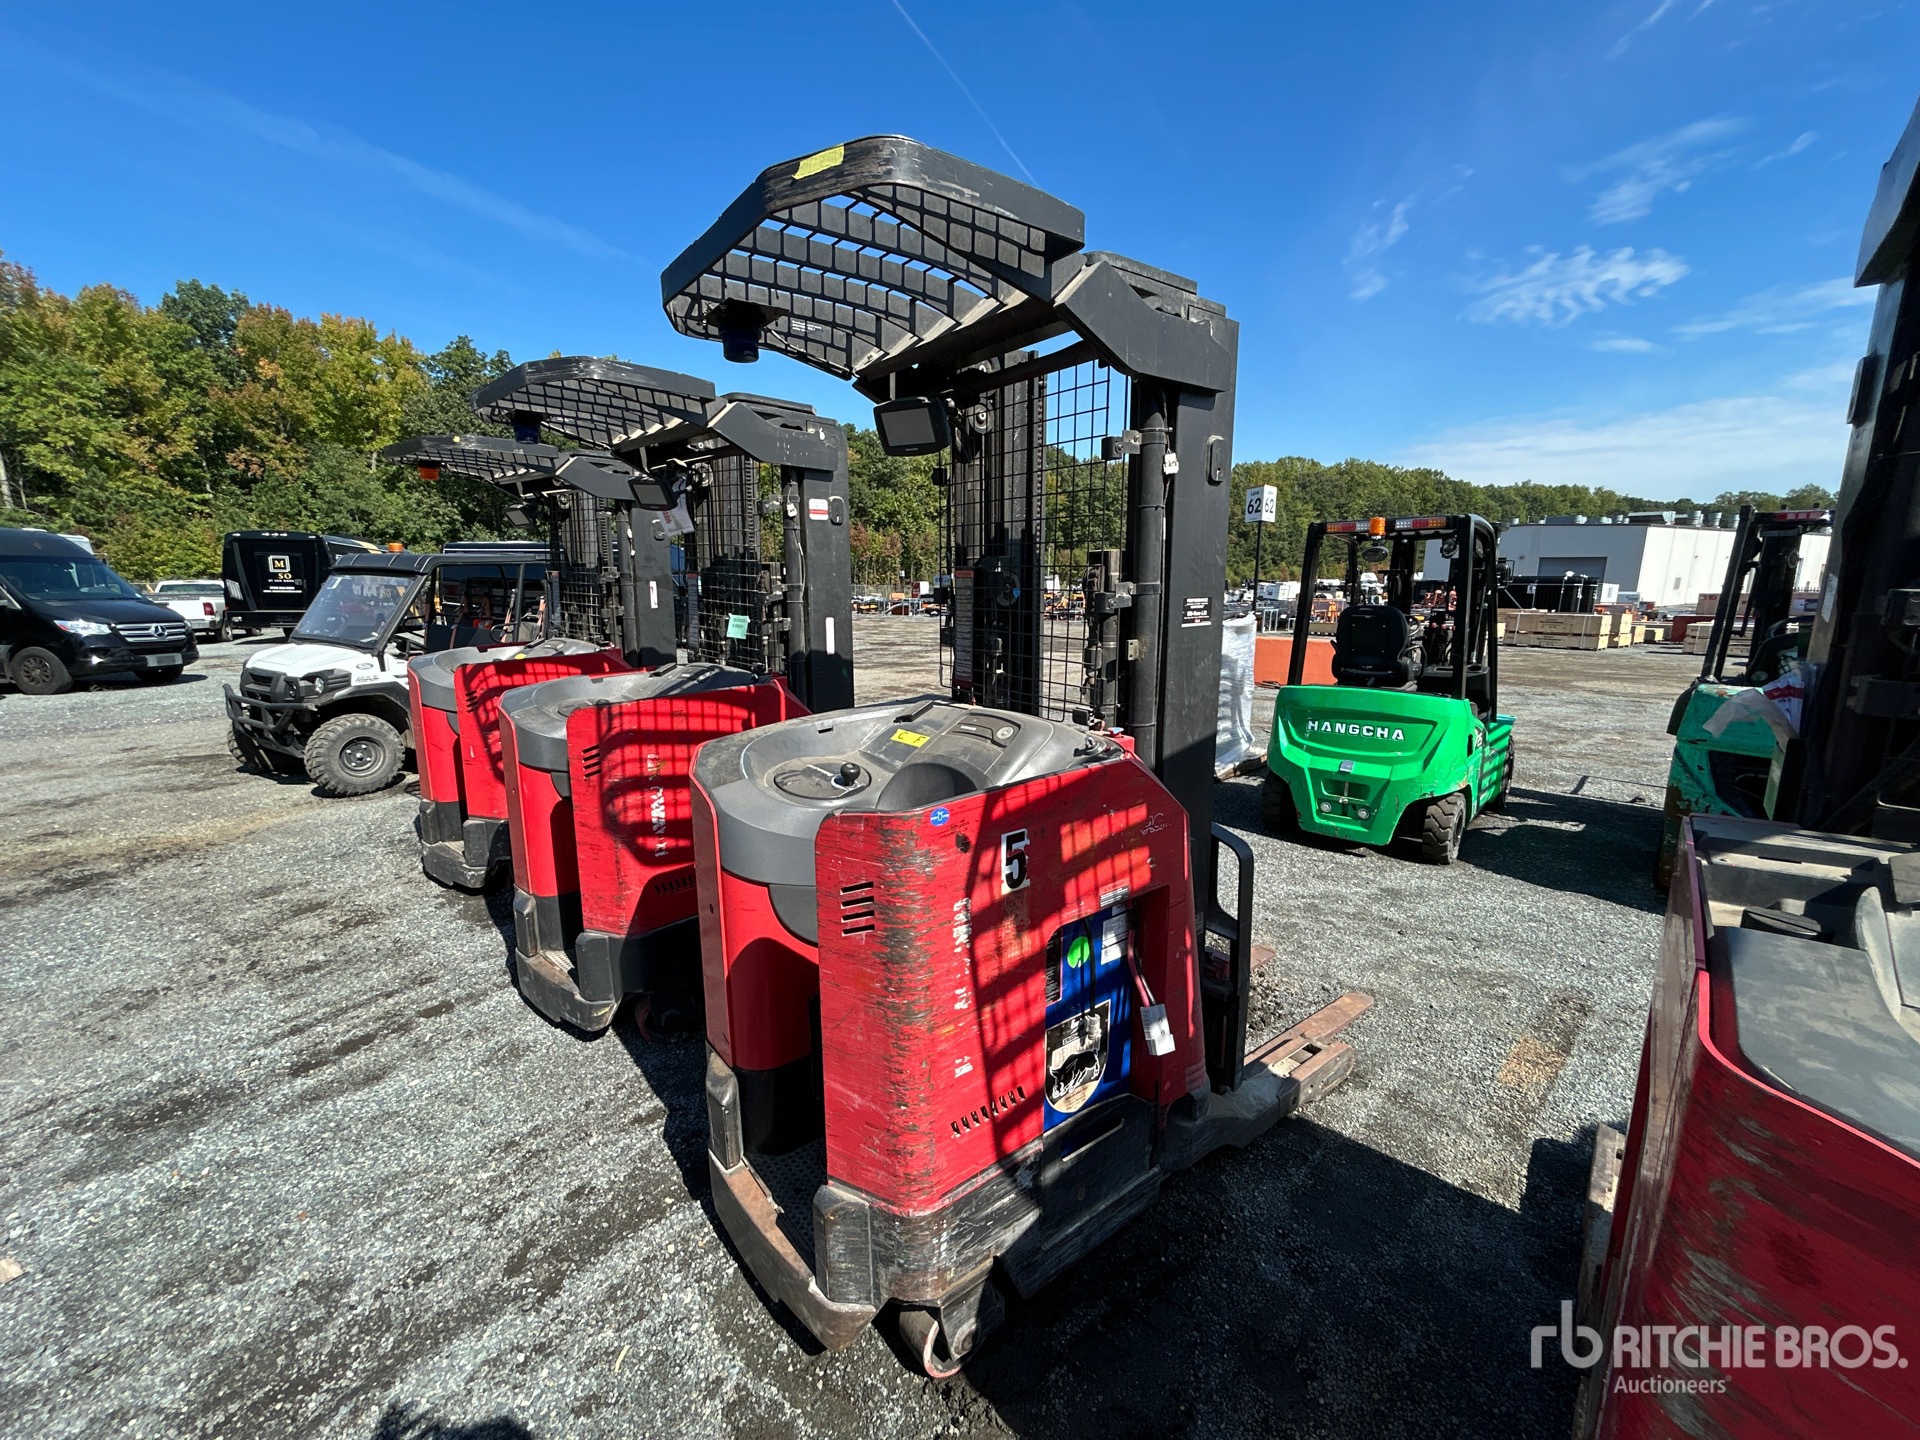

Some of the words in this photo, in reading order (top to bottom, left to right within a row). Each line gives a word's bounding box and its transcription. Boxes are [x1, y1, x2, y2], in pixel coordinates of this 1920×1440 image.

[1247, 497, 1262, 515] 62
[1264, 498, 1275, 514] 62
[274, 560, 285, 568] M
[1307, 720, 1405, 741] HANGCHA
[1005, 830, 1028, 890] 5
